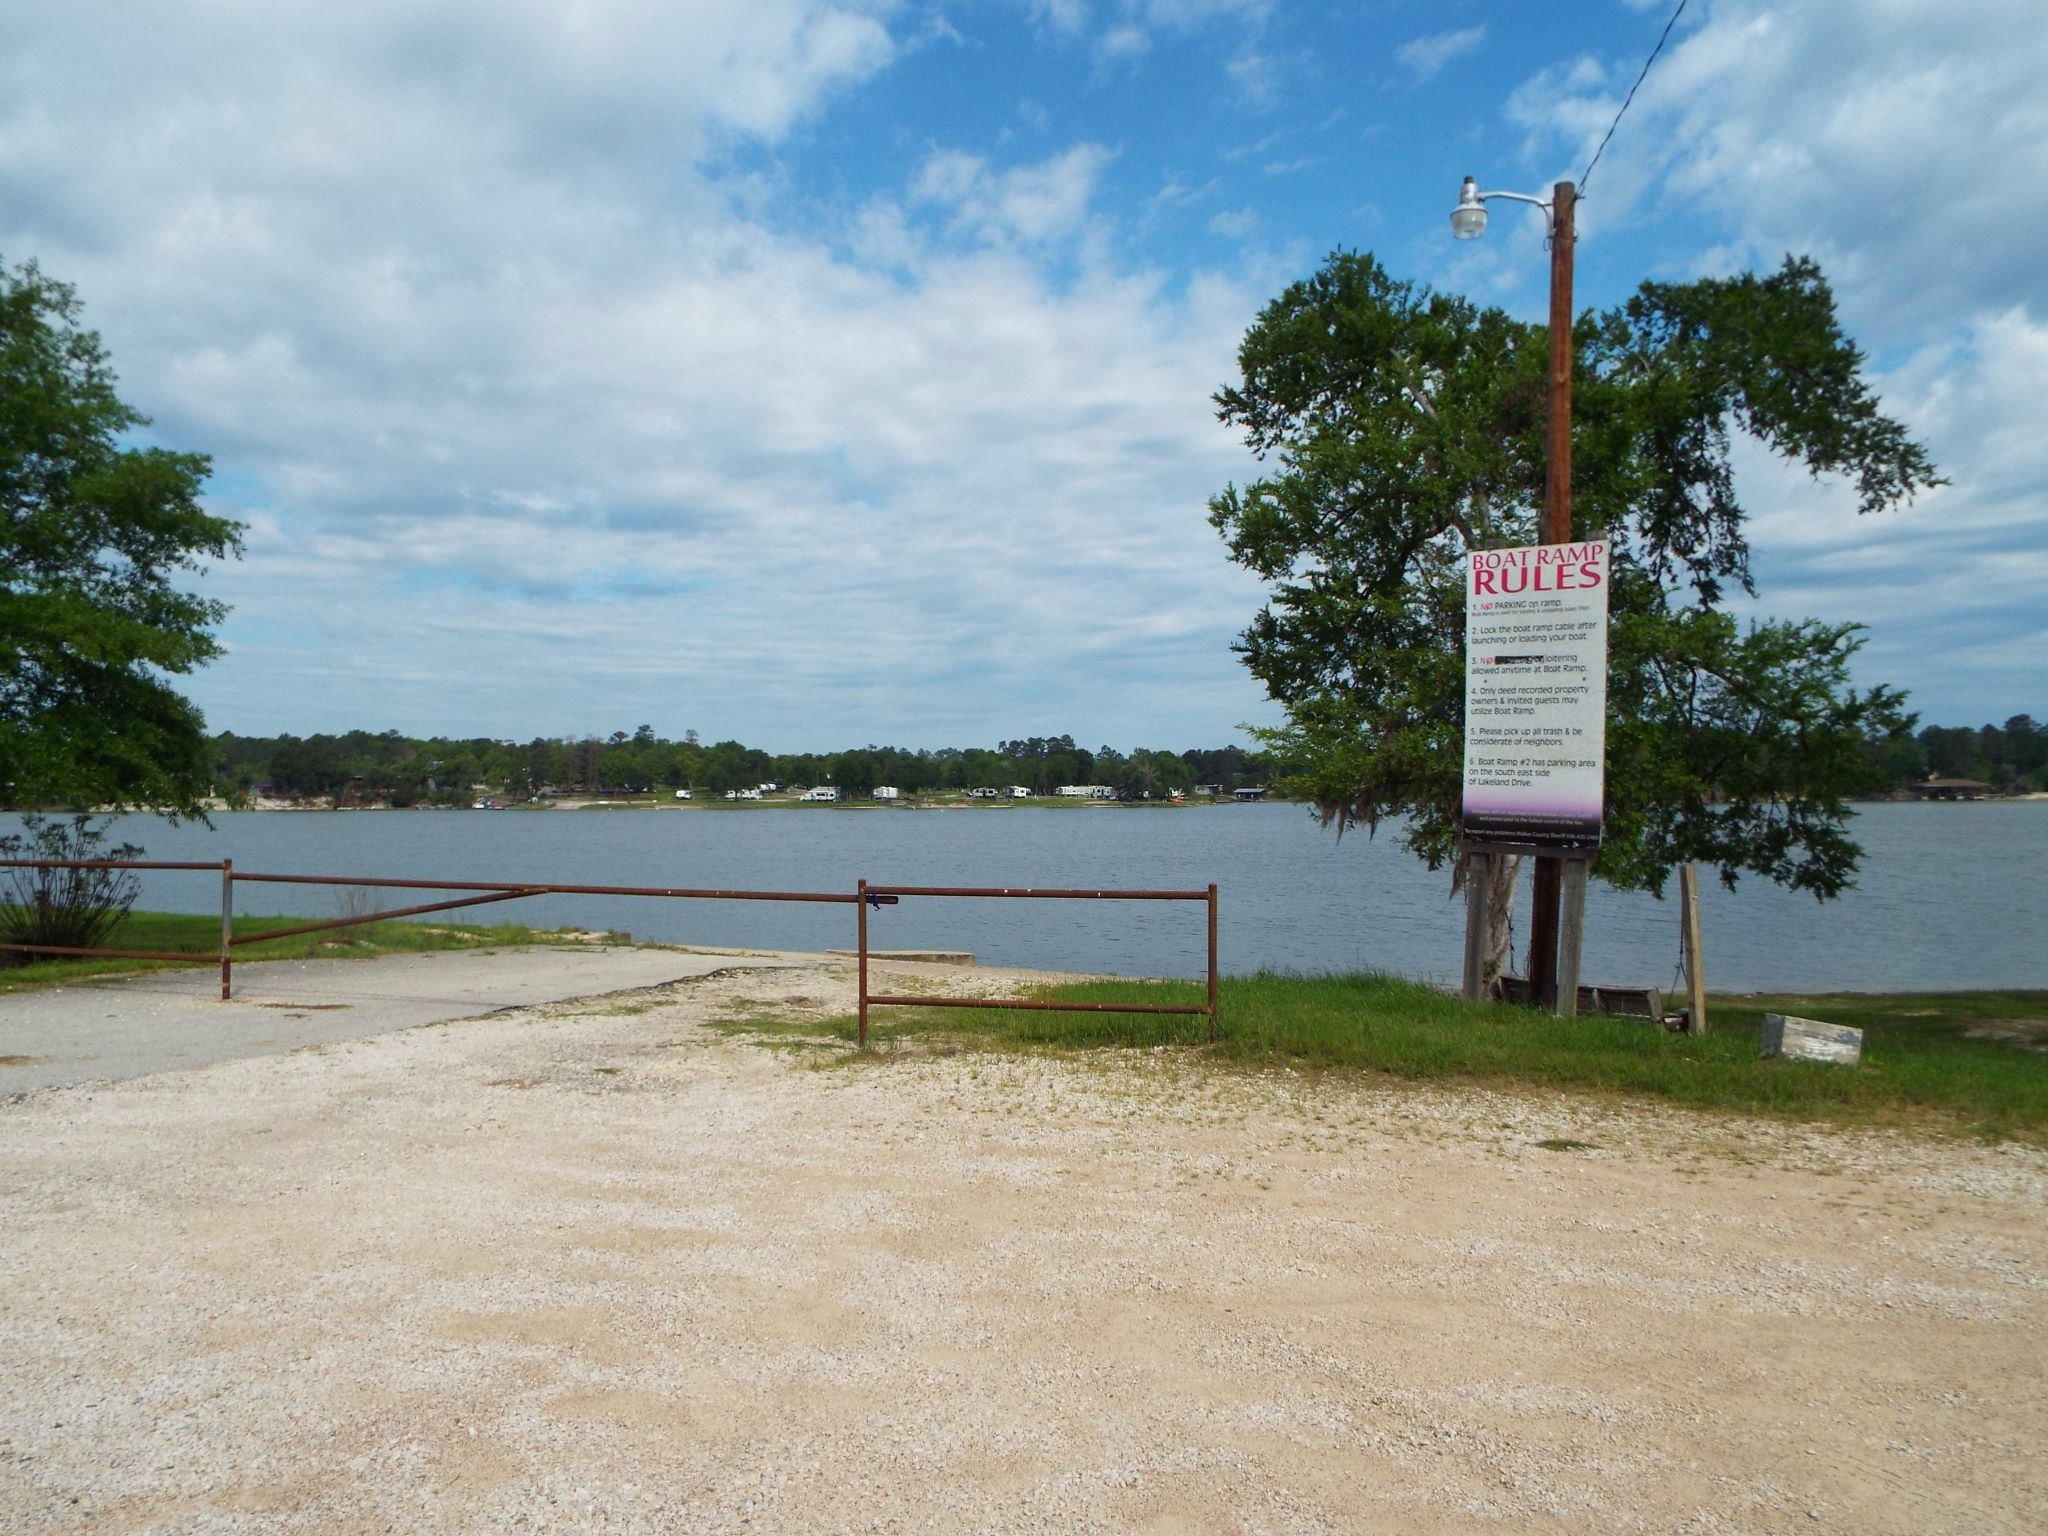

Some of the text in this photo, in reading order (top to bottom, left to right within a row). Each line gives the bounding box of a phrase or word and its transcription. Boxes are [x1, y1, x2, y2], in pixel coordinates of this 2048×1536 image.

[1473, 544, 1603, 570] BOAT RAMP
[1475, 561, 1601, 595] RULES
[1494, 600, 1527, 609] PARKING
[1528, 600, 1539, 608] on
[1480, 626, 1497, 634] Lock
[1513, 625, 1530, 633] boat
[1472, 635, 1507, 645] launching
[1519, 635, 1547, 643] loading
[1548, 634, 1567, 642] your
[1545, 654, 1578, 662] loitering
[1472, 666, 1500, 675] allowed
[1501, 666, 1531, 674] anytime
[1533, 665, 1542, 673] at
[1480, 687, 1496, 695] Only
[1518, 686, 1552, 694] recorded
[1554, 686, 1589, 694] property
[1534, 696, 1560, 705] guests
[1562, 696, 1578, 704] may
[1470, 707, 1493, 715] utilize
[1494, 707, 1511, 715] Boat
[1479, 727, 1502, 735] Please
[1504, 727, 1518, 736] pick
[1520, 728, 1530, 736] up
[1532, 727, 1540, 735] all
[1543, 727, 1562, 735] trash
[1565, 727, 1570, 735] &
[1572, 727, 1582, 735] be
[1470, 738, 1512, 746] considerate
[1497, 758, 1518, 766] Ramp
[1547, 759, 1576, 768] parking
[1494, 768, 1515, 776] south
[1535, 768, 1550, 776] side
[1478, 778, 1509, 786] Lakeland
